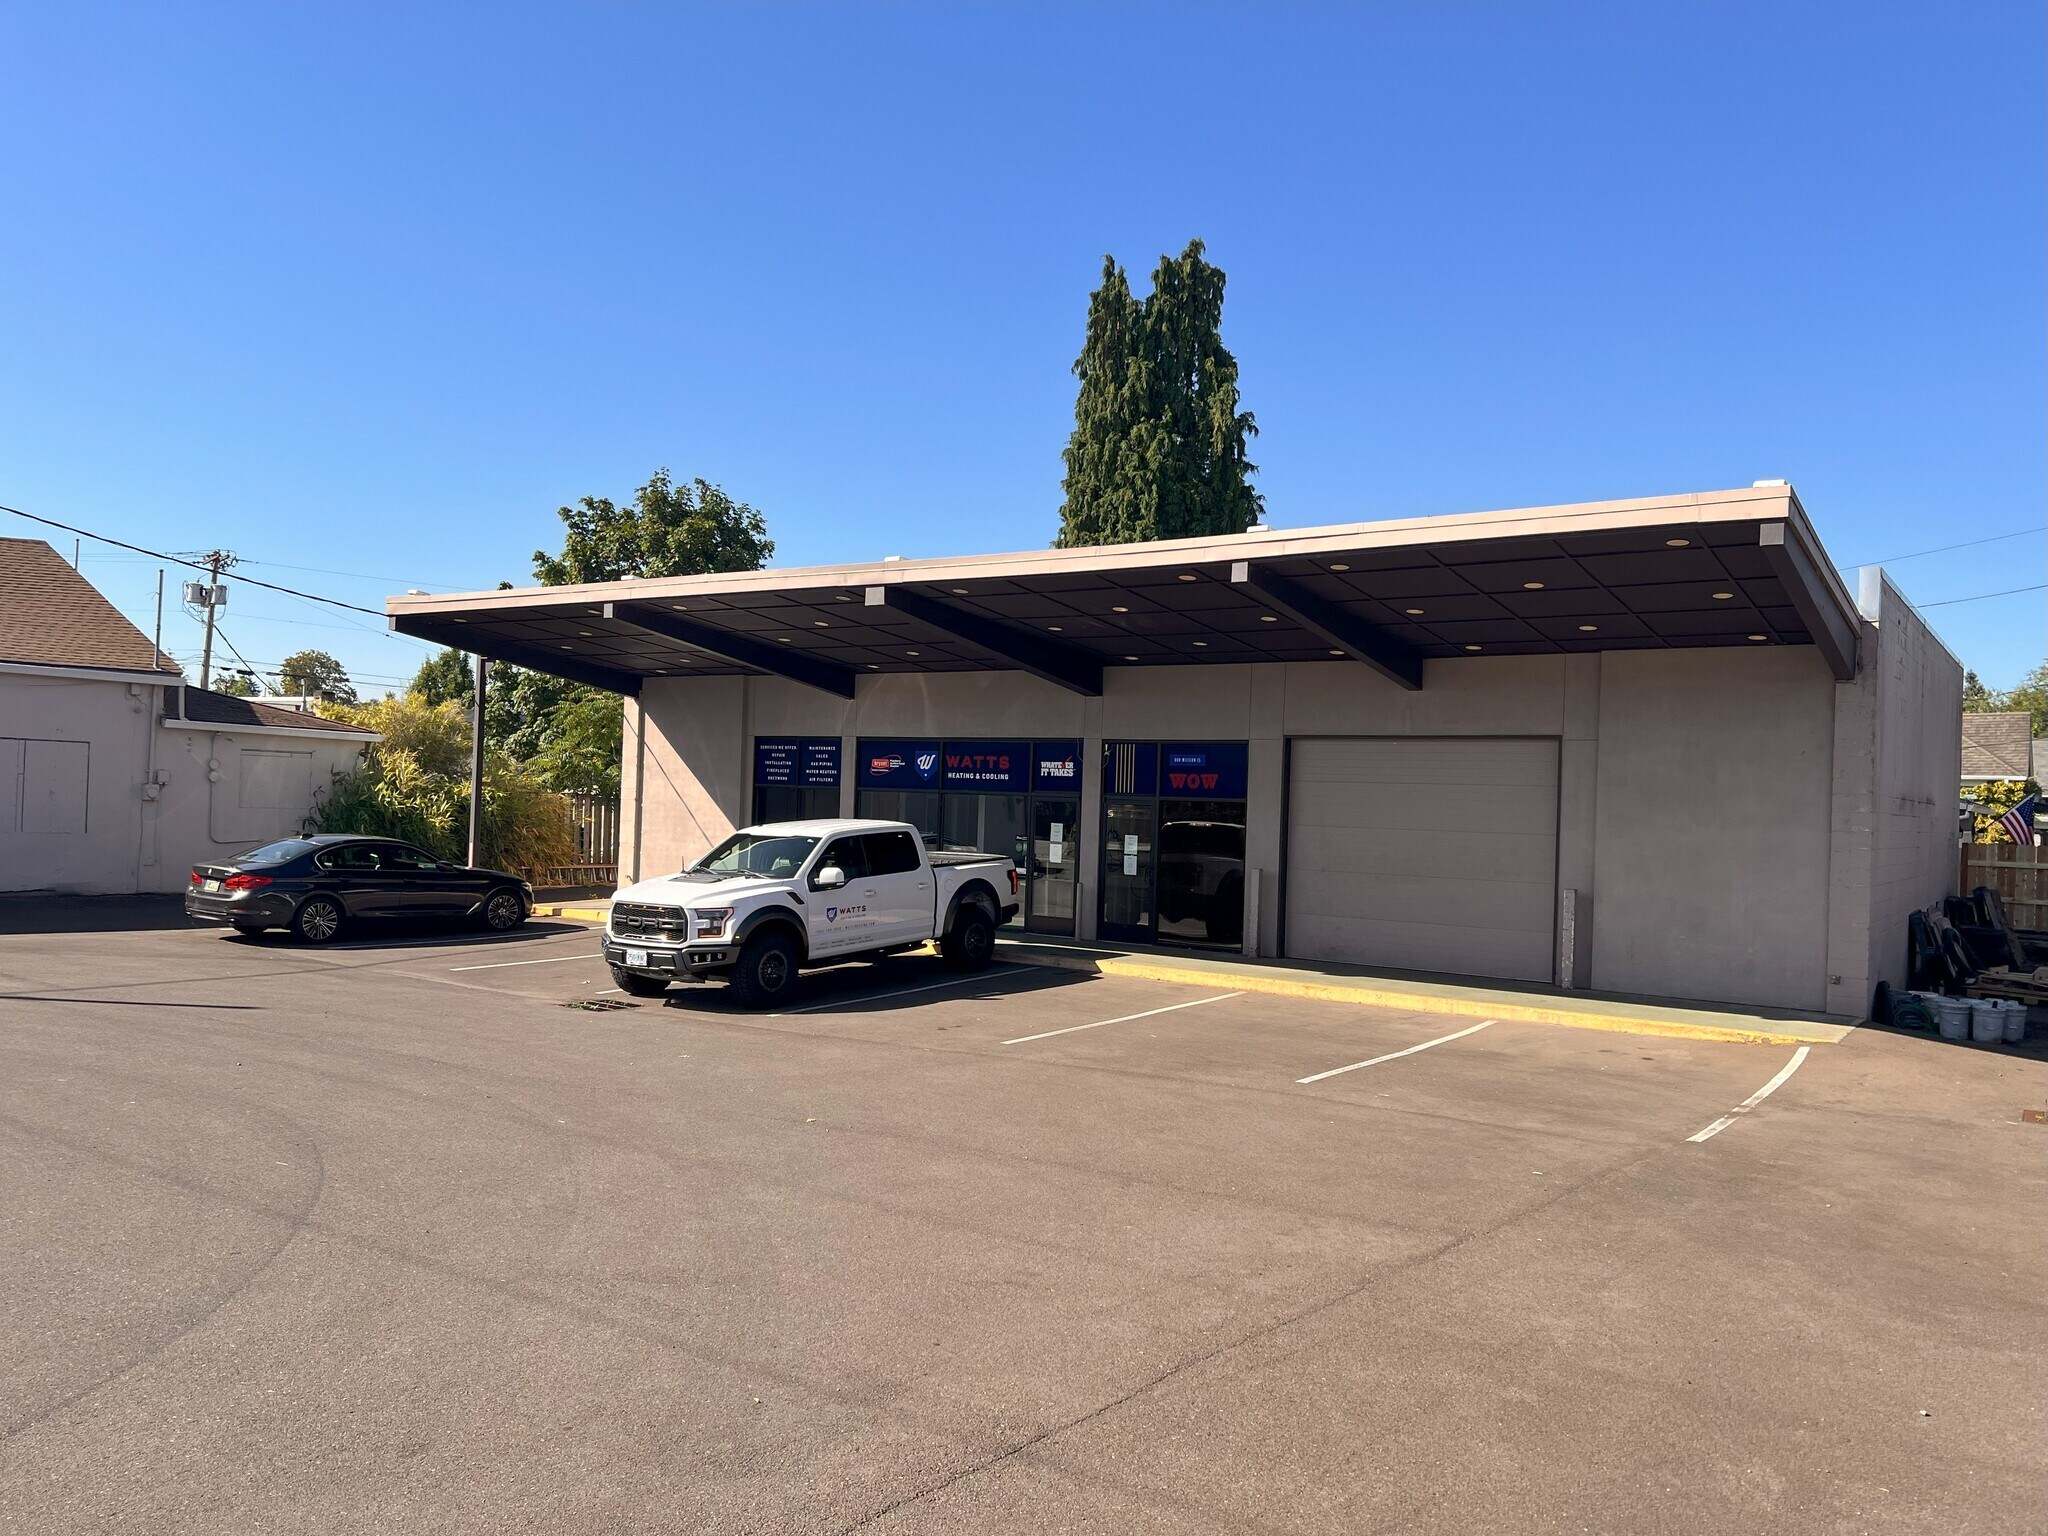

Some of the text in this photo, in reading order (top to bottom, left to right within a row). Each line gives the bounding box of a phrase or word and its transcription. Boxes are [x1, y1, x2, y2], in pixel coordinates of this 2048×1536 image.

[946, 756, 1010, 769] WATTS
[1050, 769, 1074, 777] TAKES
[1169, 774, 1219, 789] WOW
[840, 905, 867, 914] WATTS
[613, 914, 677, 928] FORD
